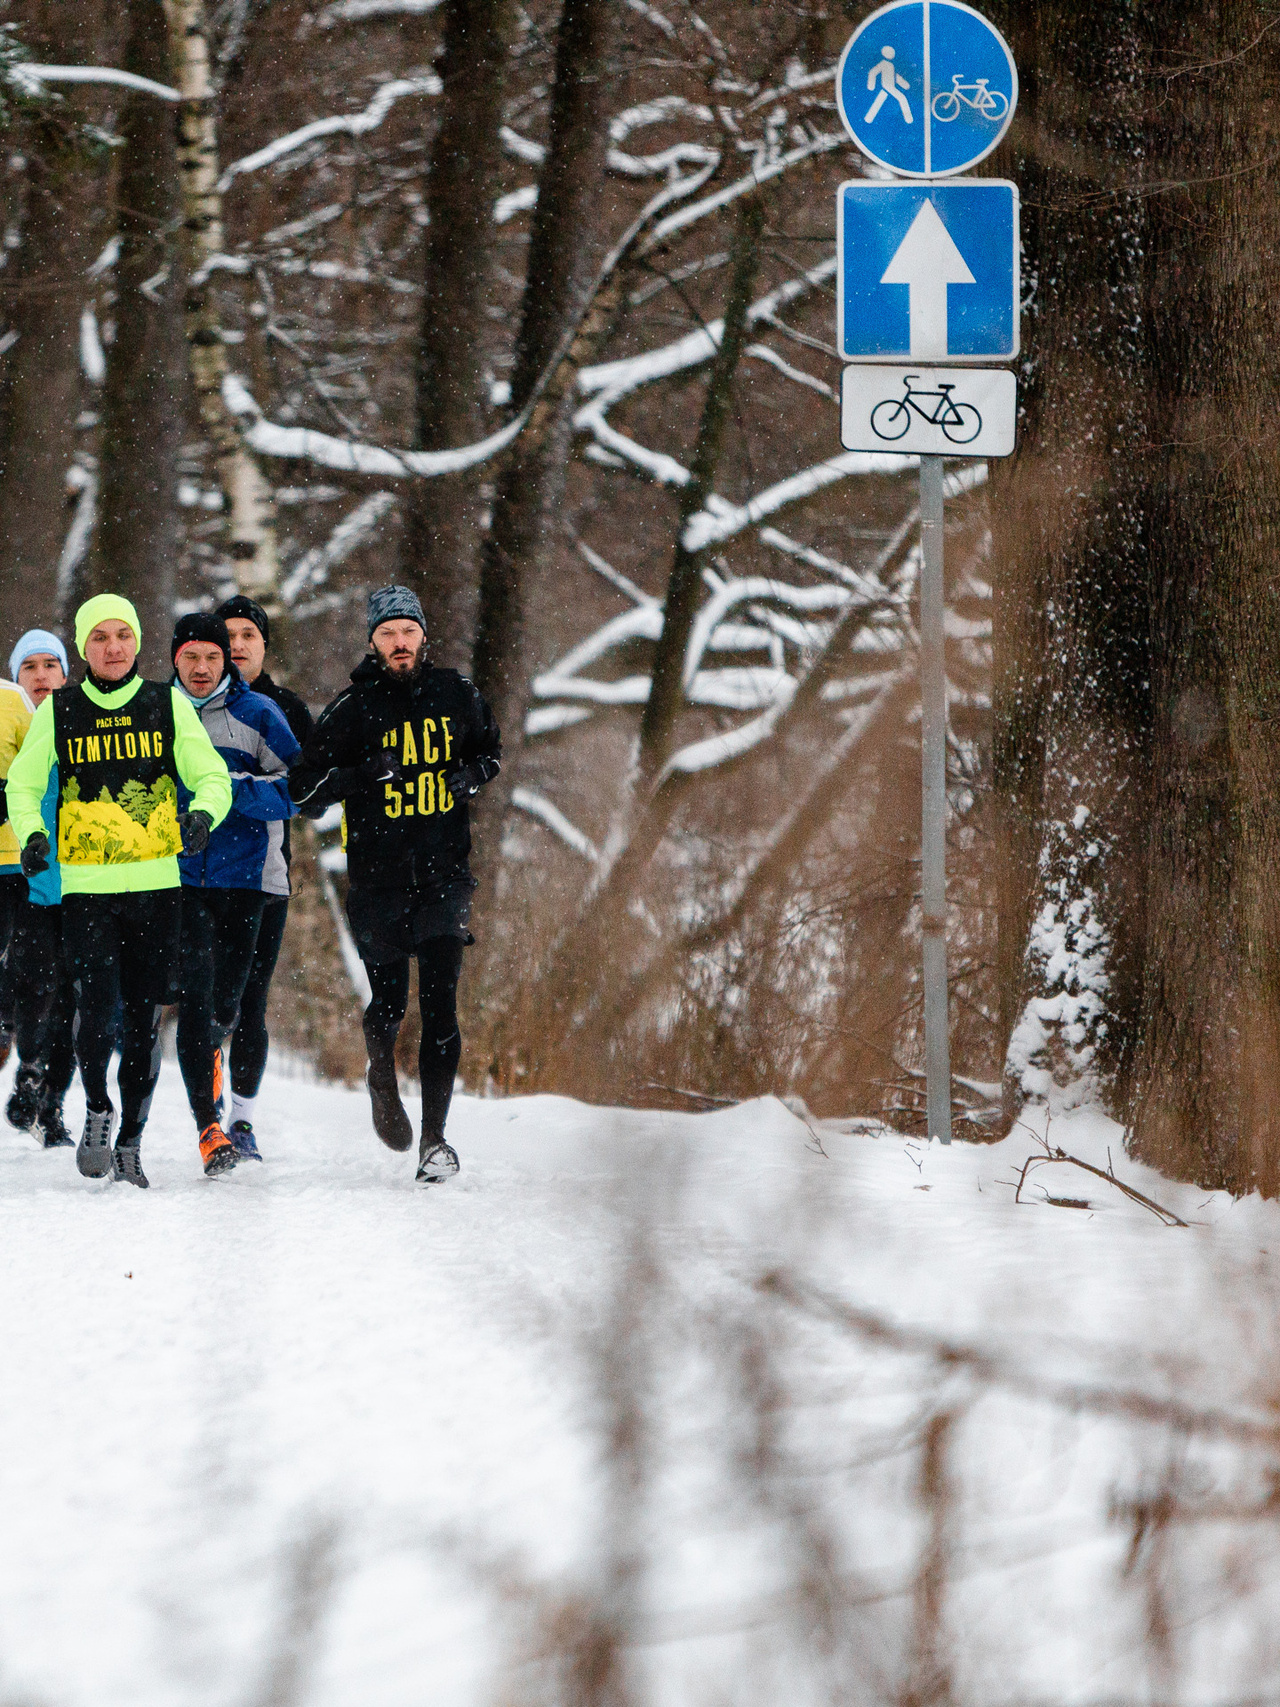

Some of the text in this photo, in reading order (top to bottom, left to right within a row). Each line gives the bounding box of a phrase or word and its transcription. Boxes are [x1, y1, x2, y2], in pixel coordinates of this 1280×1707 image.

[96, 716, 132, 729] PACE 5:00
[67, 731, 163, 765] IZMYLONG
